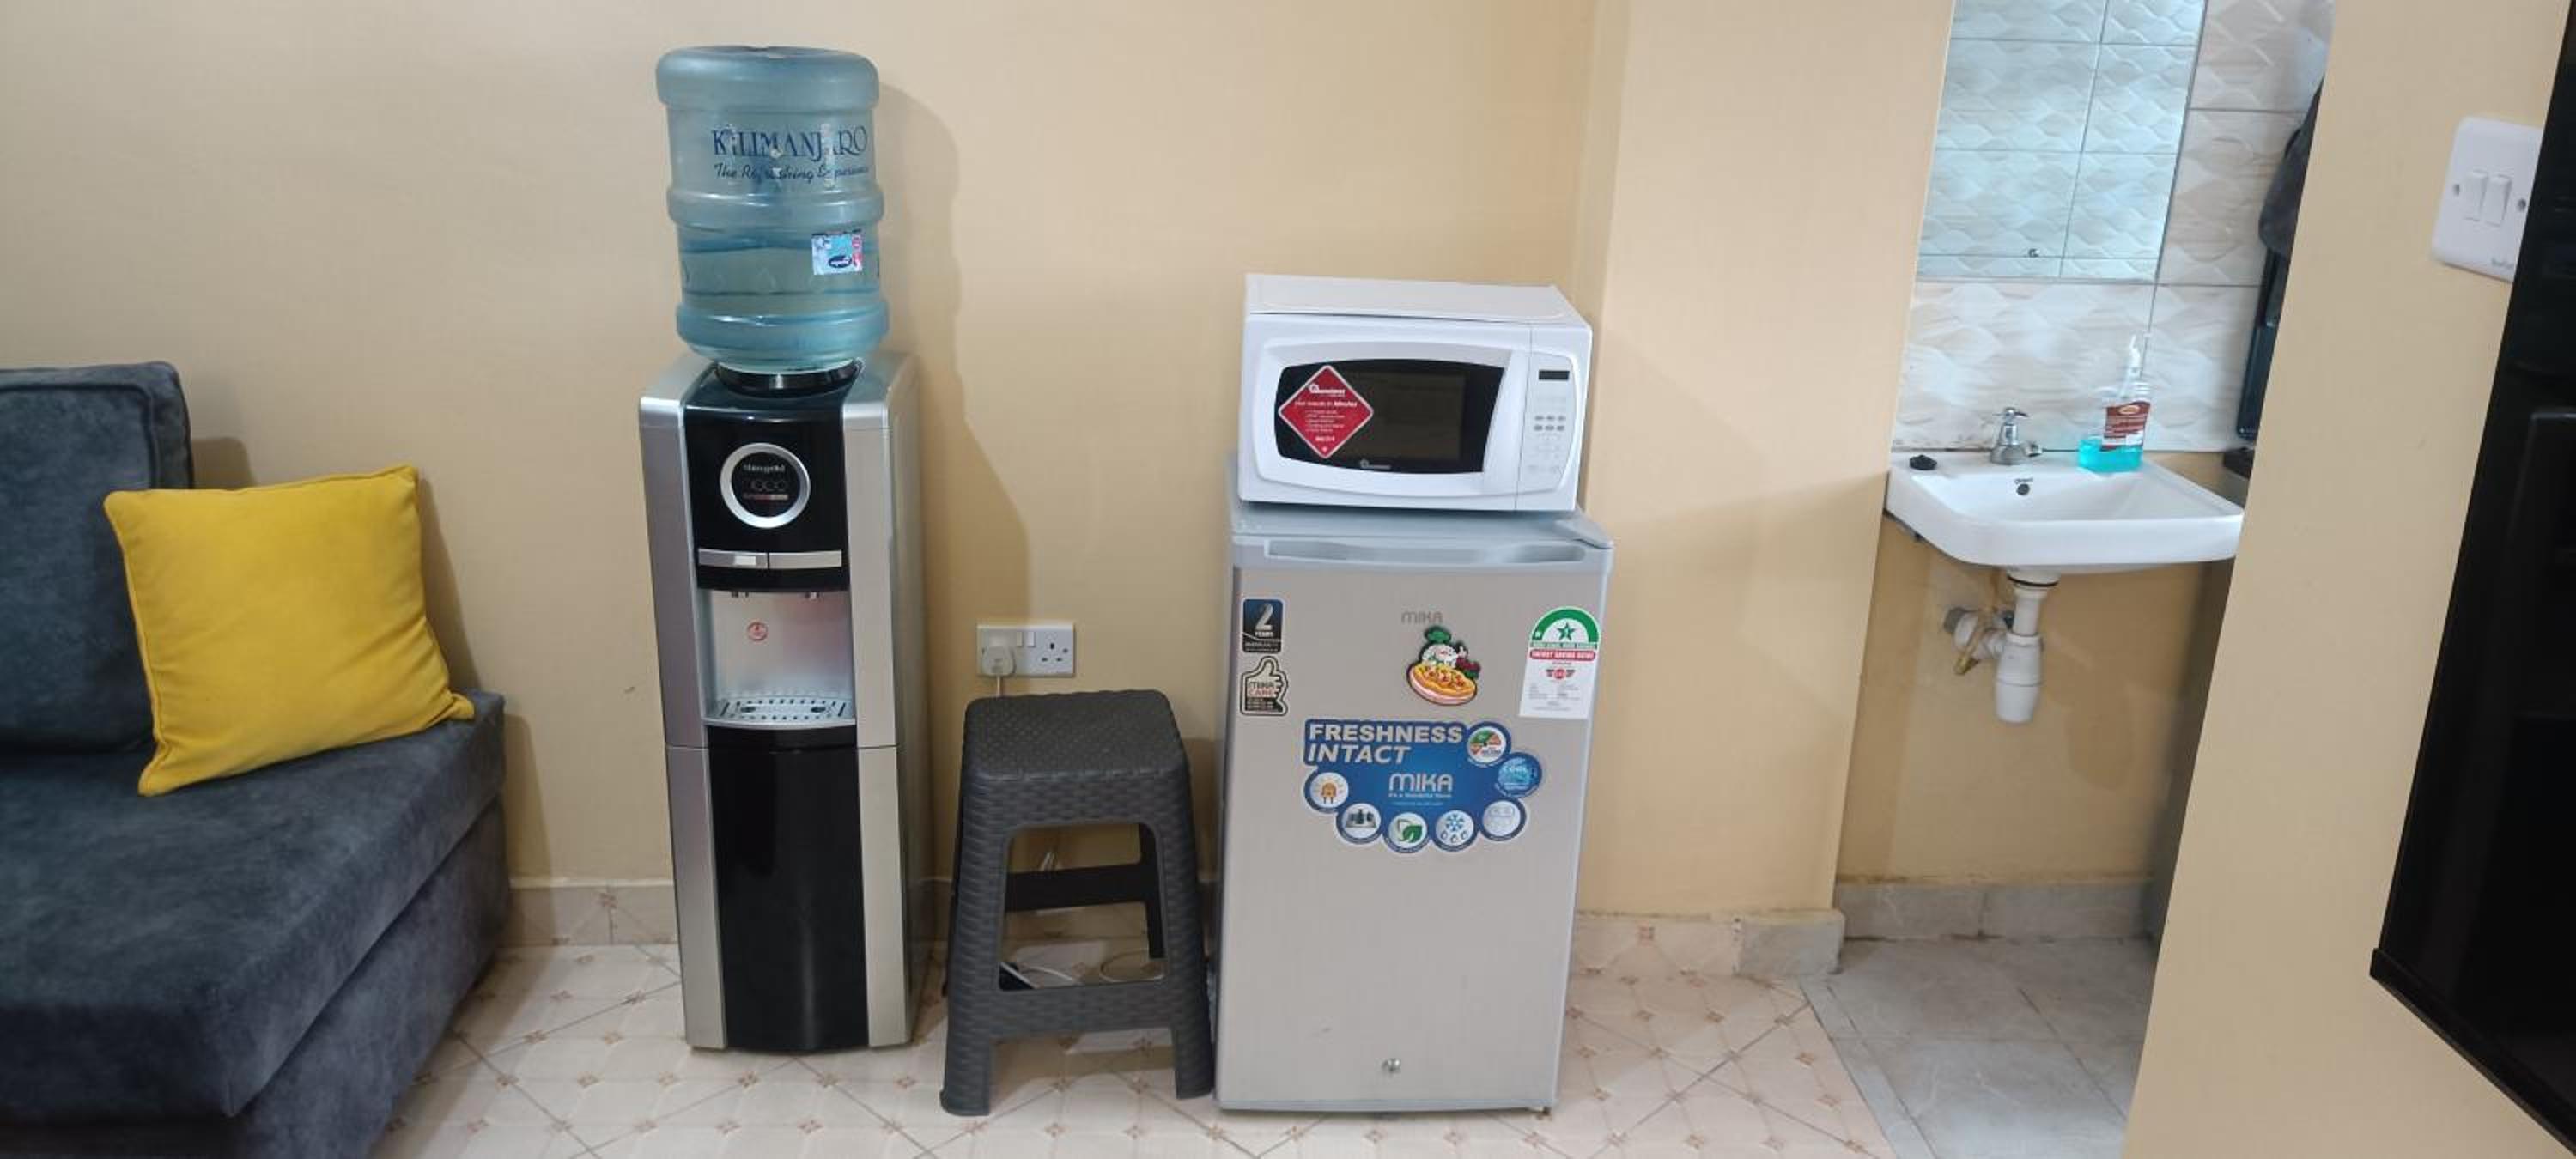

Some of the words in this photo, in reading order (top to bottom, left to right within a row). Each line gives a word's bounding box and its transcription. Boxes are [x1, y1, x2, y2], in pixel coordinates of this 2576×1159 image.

[712, 126, 868, 162] KILIMANJRO
[714, 163, 734, 179] The
[1255, 603, 1274, 631] 2
[1400, 610, 1444, 624] MIKA
[1309, 724, 1463, 744] FRESHNESS
[1307, 744, 1412, 764] INTACT
[1388, 773, 1454, 792] MIKA
